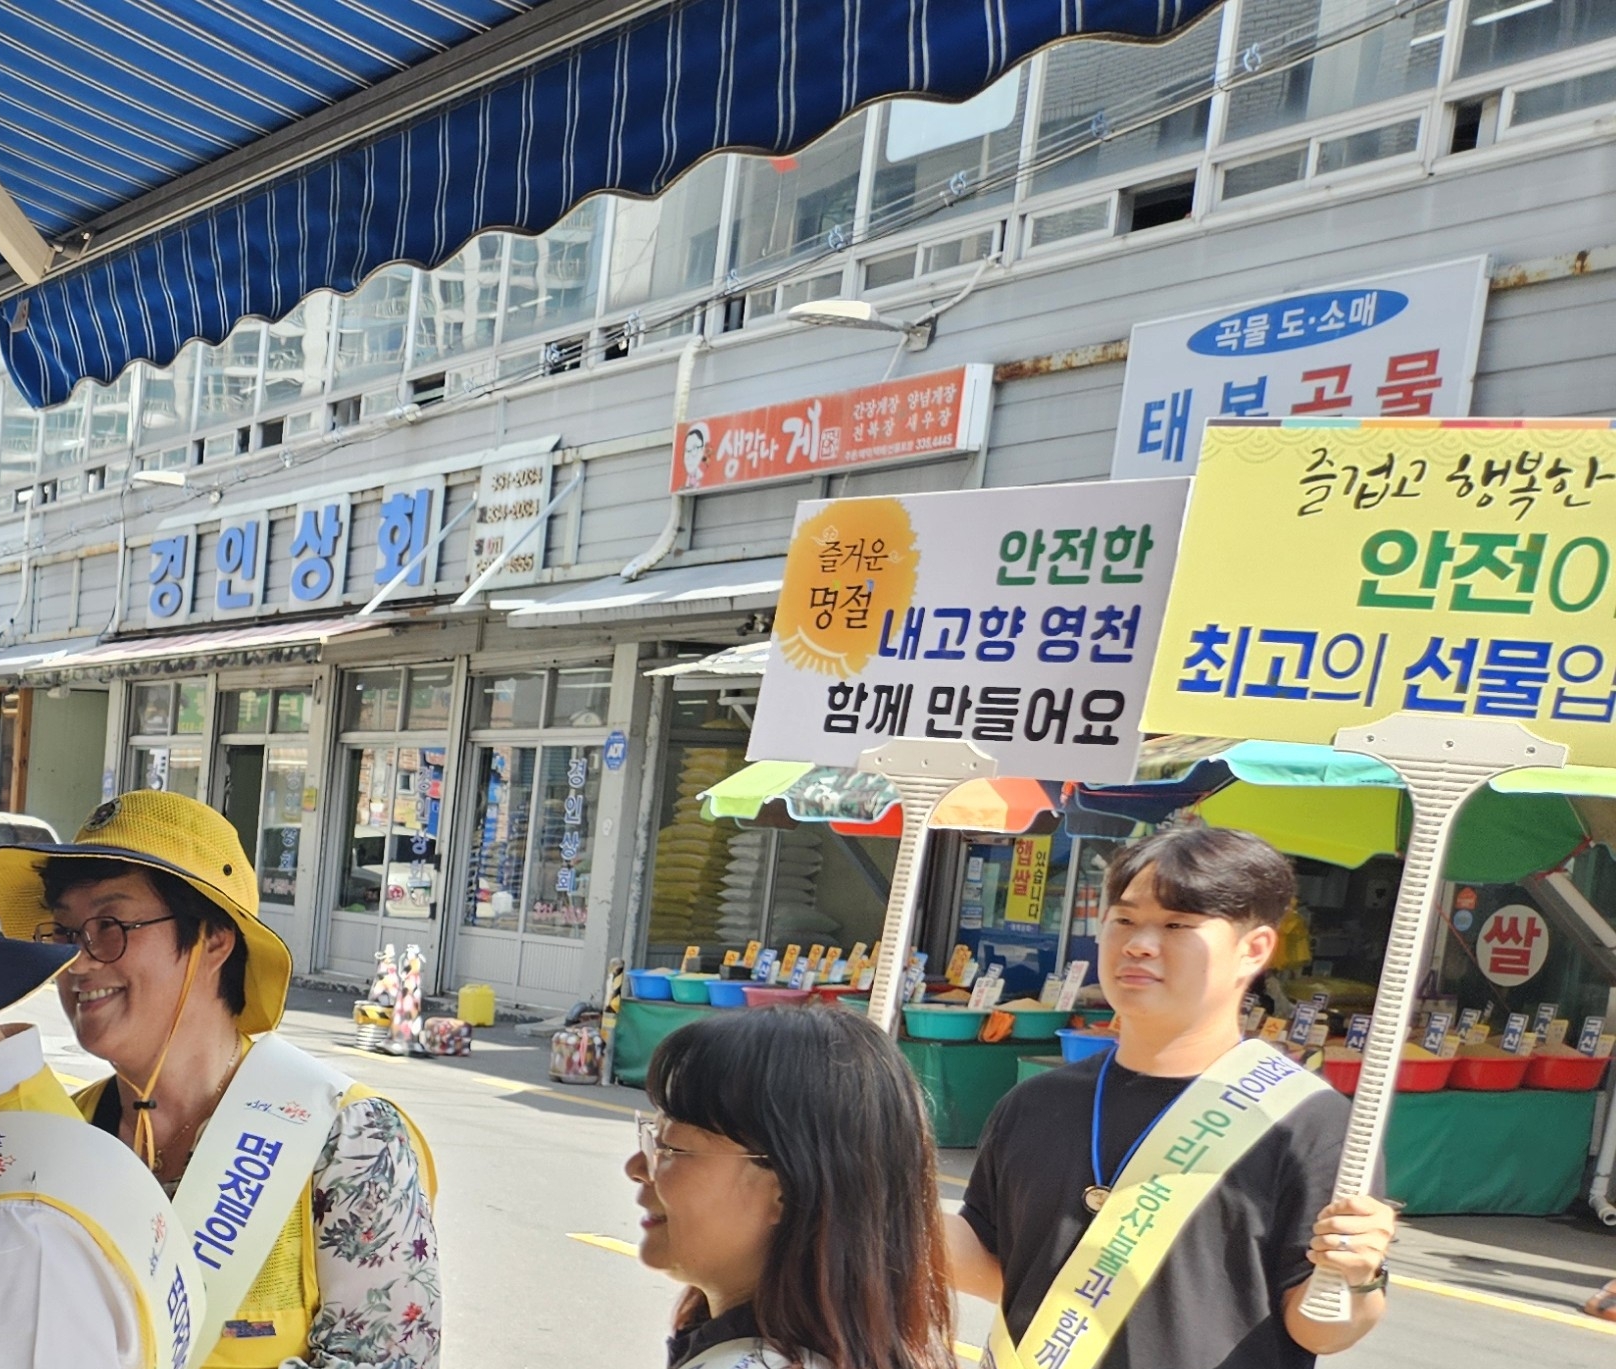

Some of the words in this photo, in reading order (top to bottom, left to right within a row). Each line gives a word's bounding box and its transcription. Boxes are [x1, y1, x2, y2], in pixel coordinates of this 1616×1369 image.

[1215, 318, 1270, 351] 곡물
[1277, 291, 1378, 340] 도·소매
[1298, 447, 1426, 516] 즐겁고
[1446, 450, 1616, 521] 행복한
[149, 488, 433, 617] 경인상회
[818, 539, 889, 573] 즐거운
[996, 524, 1154, 586] 안전한
[810, 584, 875, 630] 명절
[878, 605, 1027, 663] 내고향
[1037, 604, 1142, 664] 영천
[1177, 623, 1388, 707] 최고의
[823, 682, 914, 738] 함께
[925, 684, 1125, 746] 만들어요
[556, 757, 588, 893] 경인상회
[1012, 838, 1034, 897] 햅쌀
[1028, 851, 1047, 919] 있습니다
[1483, 915, 1542, 976] 쌀
[1292, 1006, 1316, 1041] 국산
[1425, 1015, 1448, 1049] 국산
[1503, 1015, 1526, 1049] 국산
[1580, 1018, 1603, 1053] 국산
[1220, 1056, 1302, 1111] 절은
[1164, 1109, 1232, 1175] 우리
[193, 1131, 283, 1270] 명절은
[1074, 1174, 1171, 1309] 농산물과
